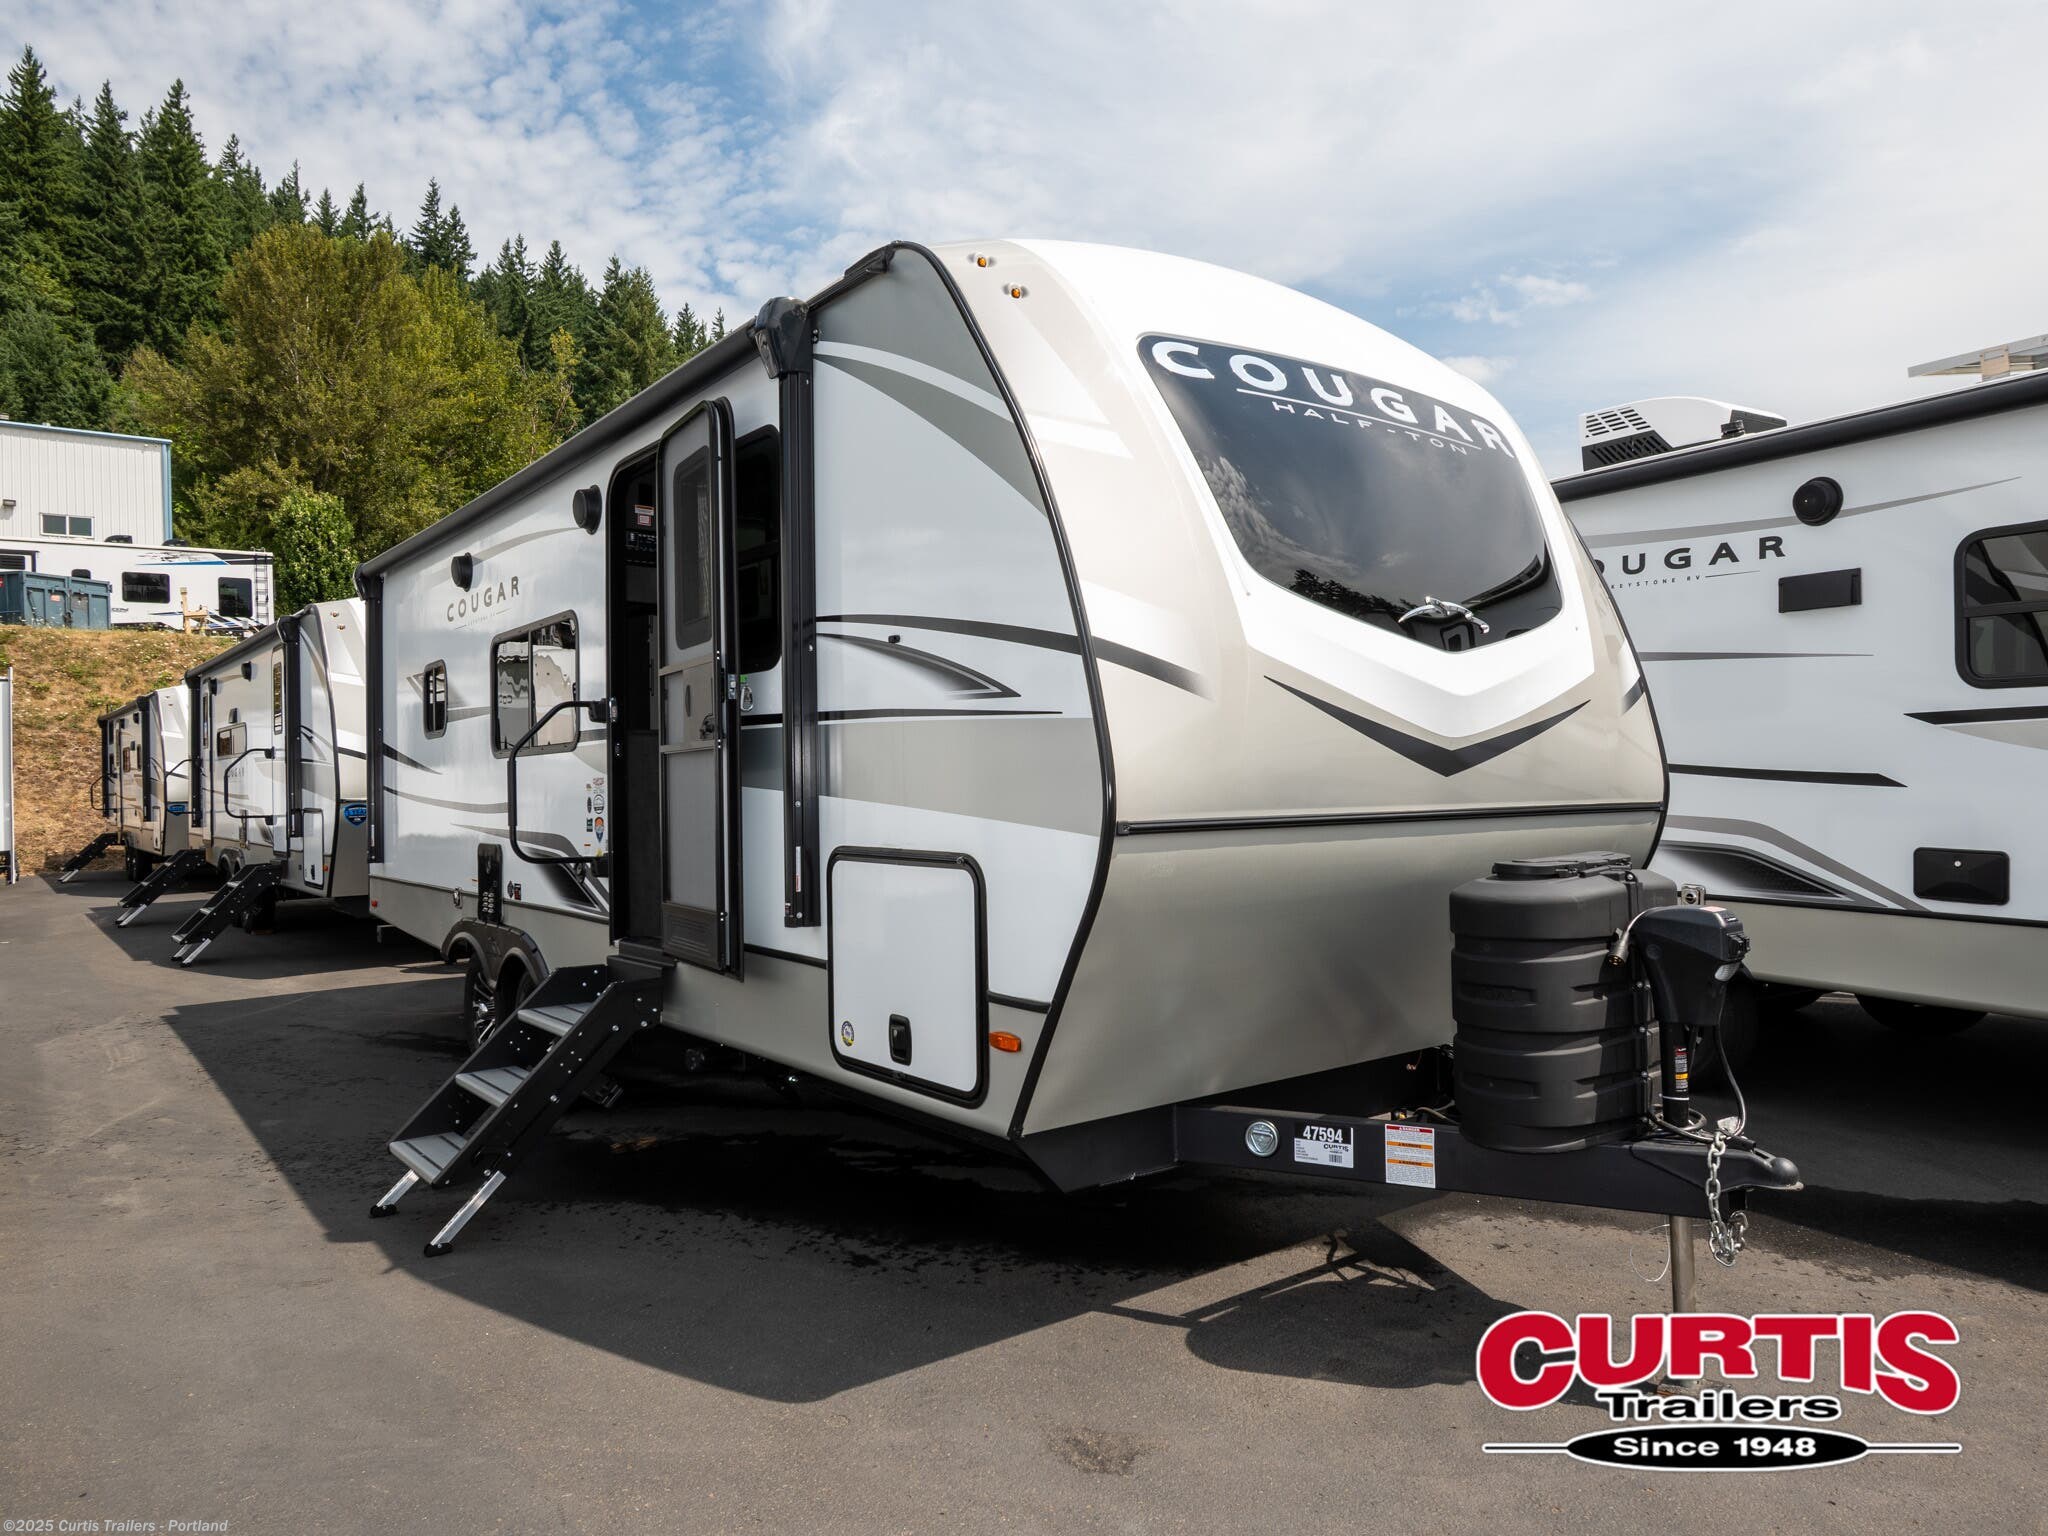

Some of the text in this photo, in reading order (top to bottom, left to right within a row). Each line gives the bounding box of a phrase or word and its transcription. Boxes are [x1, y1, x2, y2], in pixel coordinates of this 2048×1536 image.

[1151, 340, 1515, 458] COUGAR
[1610, 577, 1676, 589] KEYSTONE
[447, 575, 520, 622] COUGAR
[1303, 1125, 1343, 1143] 47594
[1323, 1143, 1349, 1152] CURTIS
